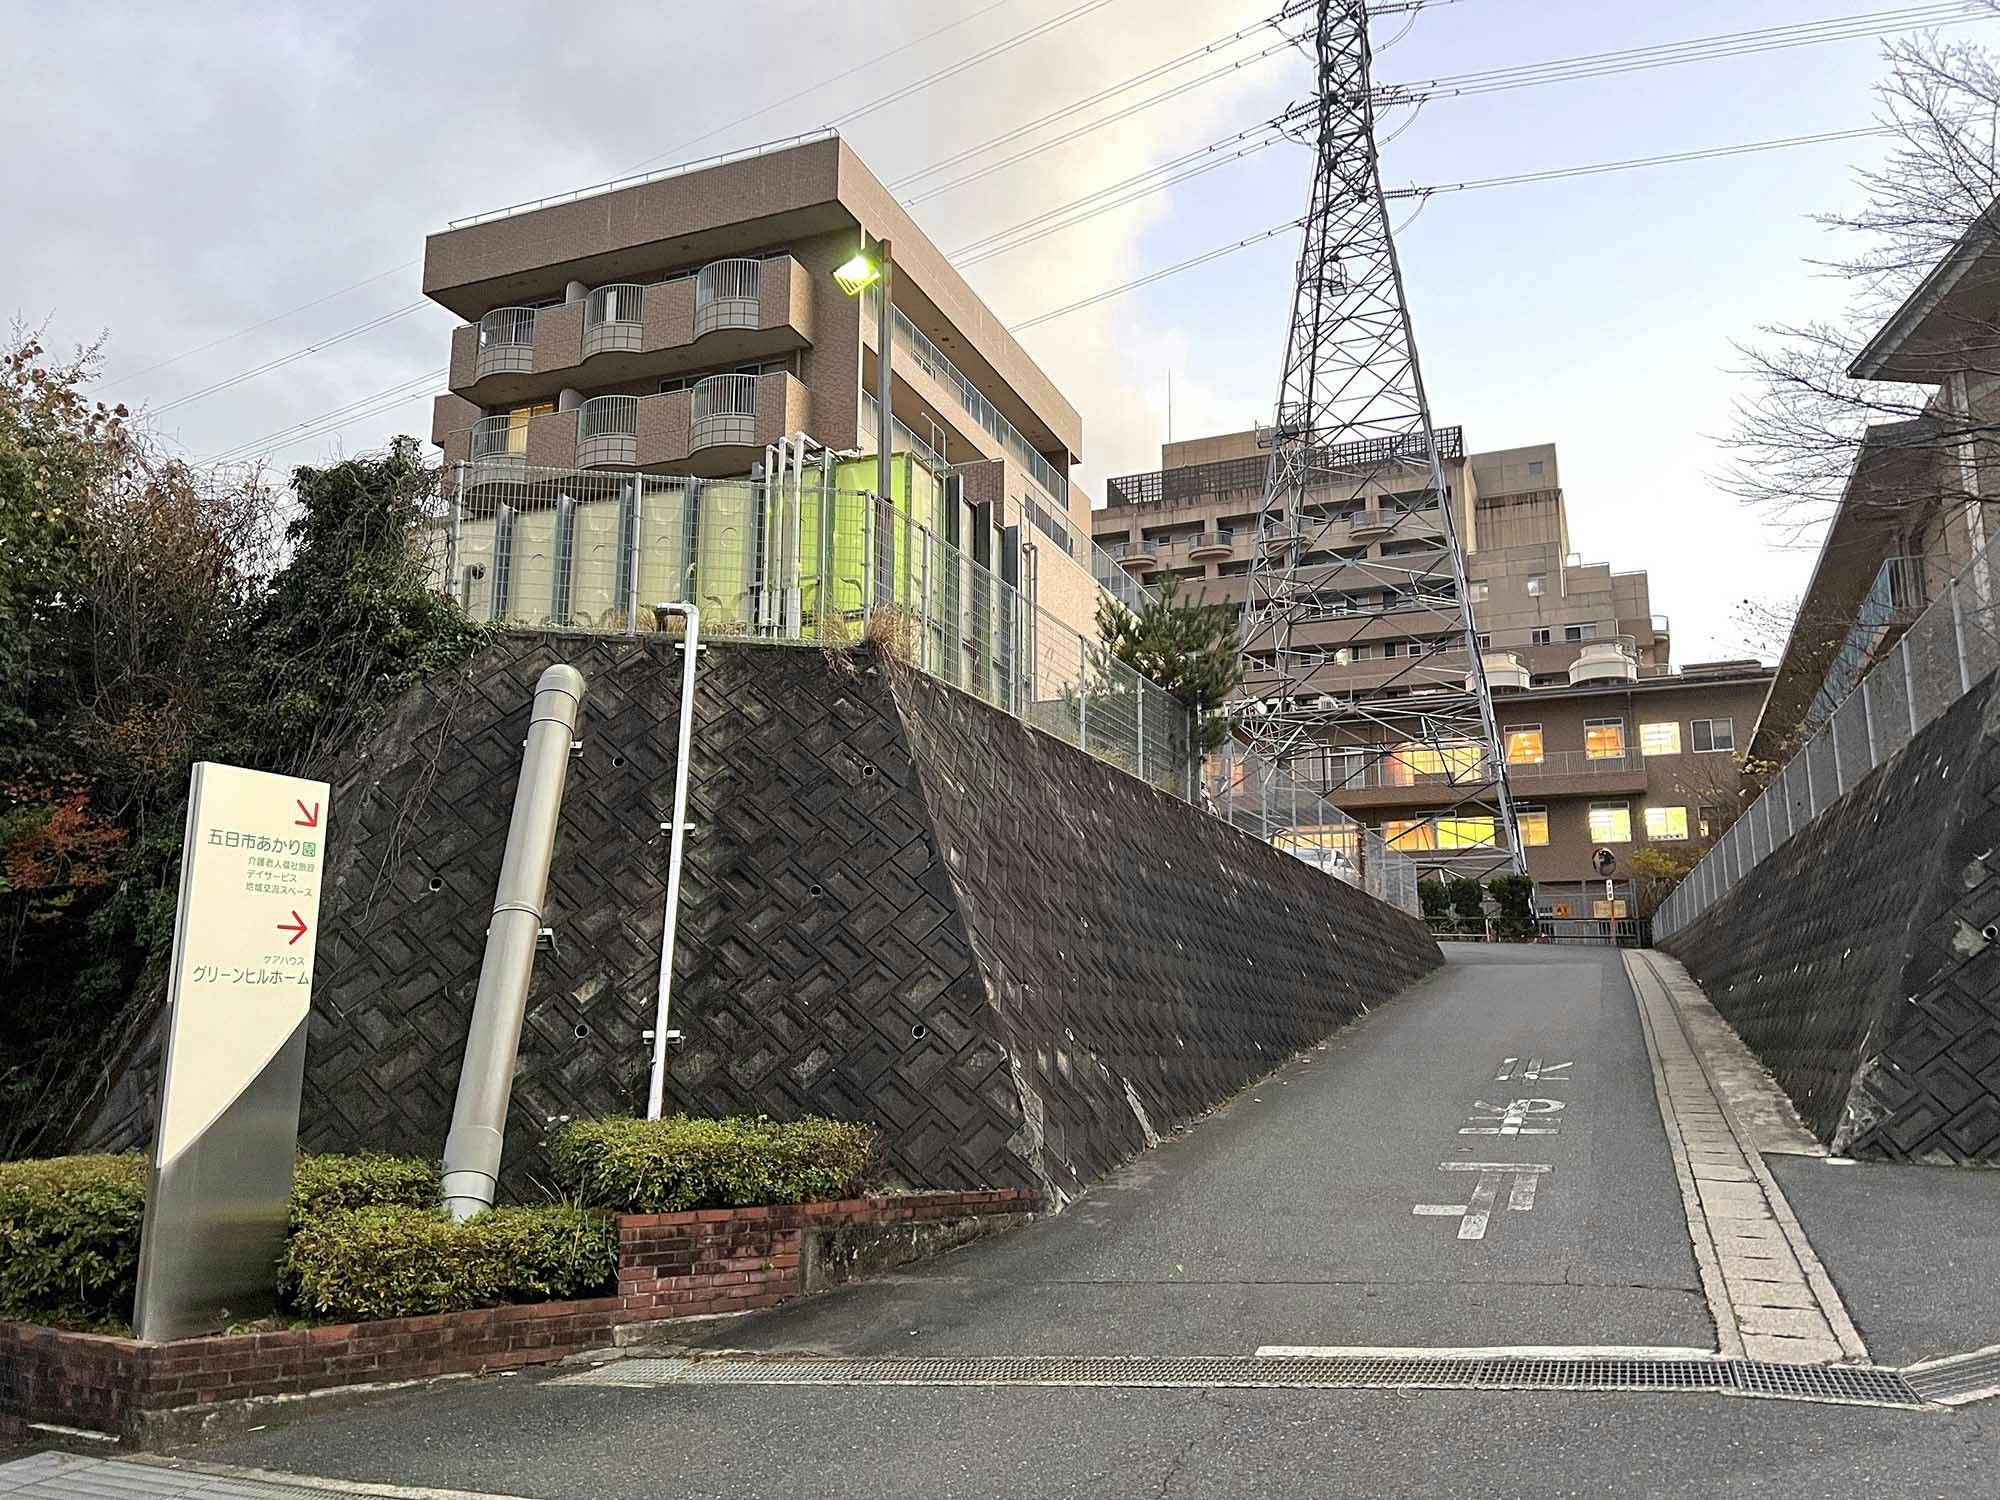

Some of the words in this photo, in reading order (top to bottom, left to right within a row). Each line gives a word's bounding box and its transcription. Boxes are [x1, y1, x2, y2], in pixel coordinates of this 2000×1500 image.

[208, 828, 316, 857] 五日市あかり園
[247, 869, 297, 883] デイサービス
[246, 882, 312, 897] 地域交流スペース
[264, 955, 305, 966] ケアハウス
[193, 965, 310, 985] グリーンヒルホーム
